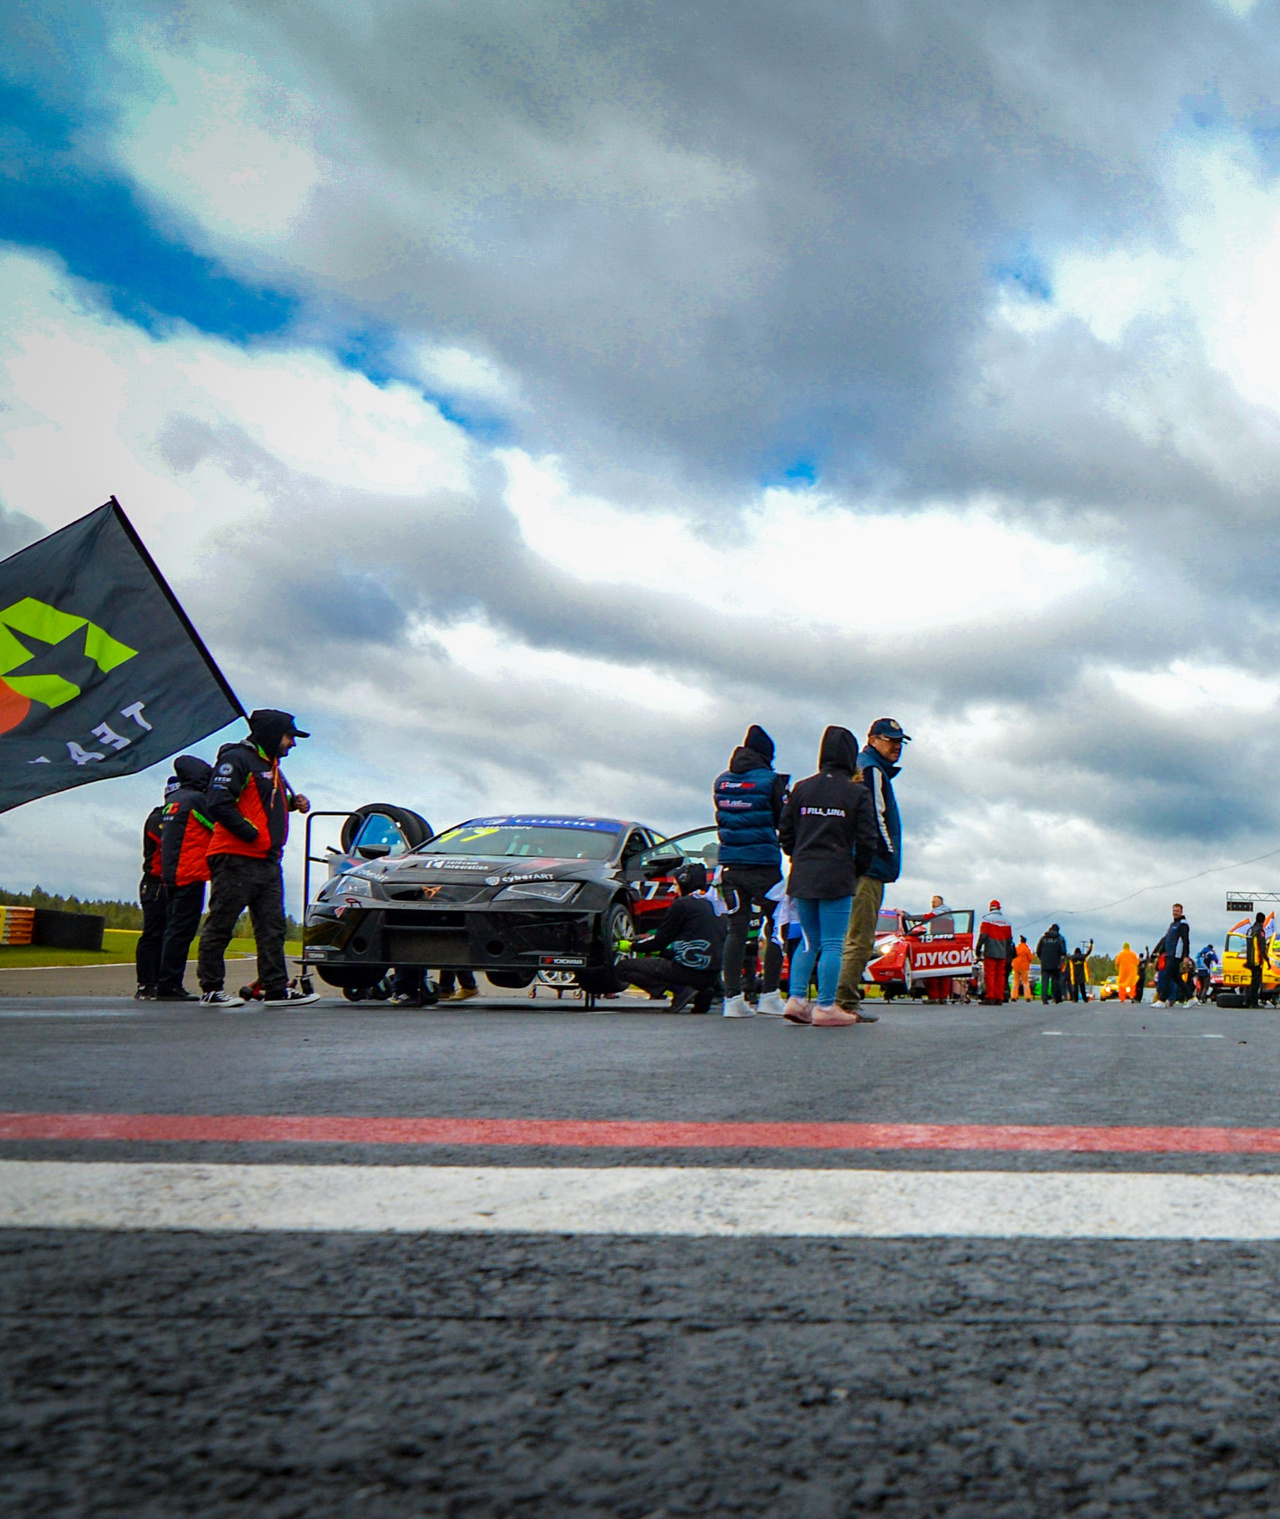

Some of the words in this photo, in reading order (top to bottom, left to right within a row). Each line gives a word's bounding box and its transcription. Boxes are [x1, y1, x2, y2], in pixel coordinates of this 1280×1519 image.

[807, 808, 846, 817] FILL_LINA
[502, 873, 554, 883] cyberART
[630, 881, 660, 900] 17
[1223, 974, 1252, 983] NEF
